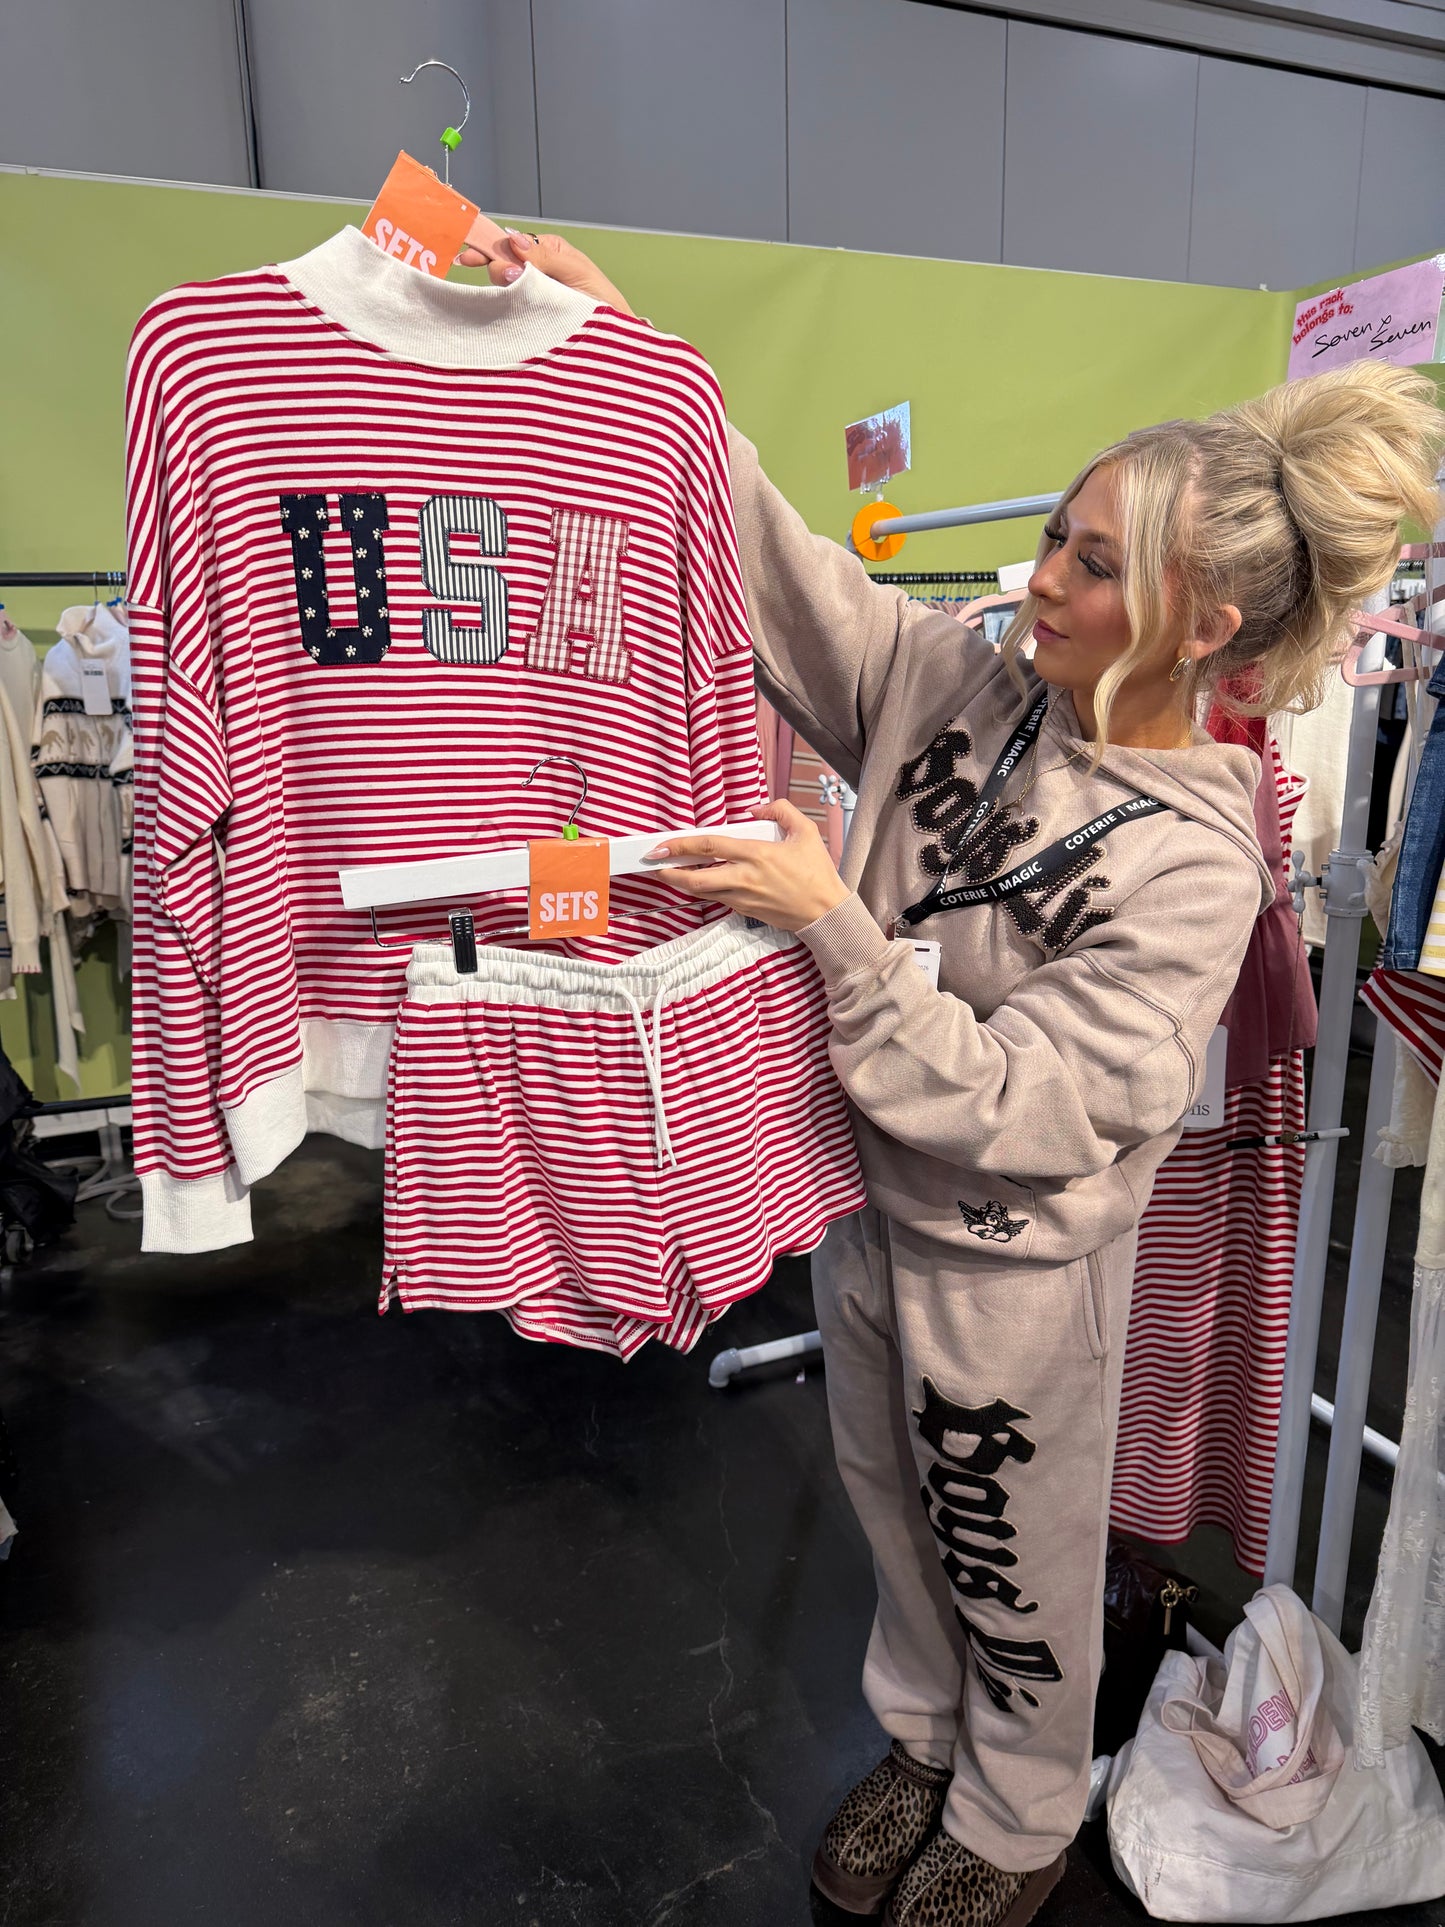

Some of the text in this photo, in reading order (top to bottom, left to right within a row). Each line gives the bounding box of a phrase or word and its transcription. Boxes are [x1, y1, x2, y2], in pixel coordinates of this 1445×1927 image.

[1293, 303, 1354, 346] belongs to:
[1297, 289, 1344, 327] this rack
[1369, 320, 1431, 352] Seven
[279, 493, 634, 684] USA
[1024, 695, 1048, 732] OTERIE
[997, 739, 1026, 777] MAGIC
[940, 888, 988, 906] COTERIE
[998, 861, 1043, 892] MAGIC
[1065, 813, 1117, 850] COTERIE
[540, 890, 599, 922] SETS
